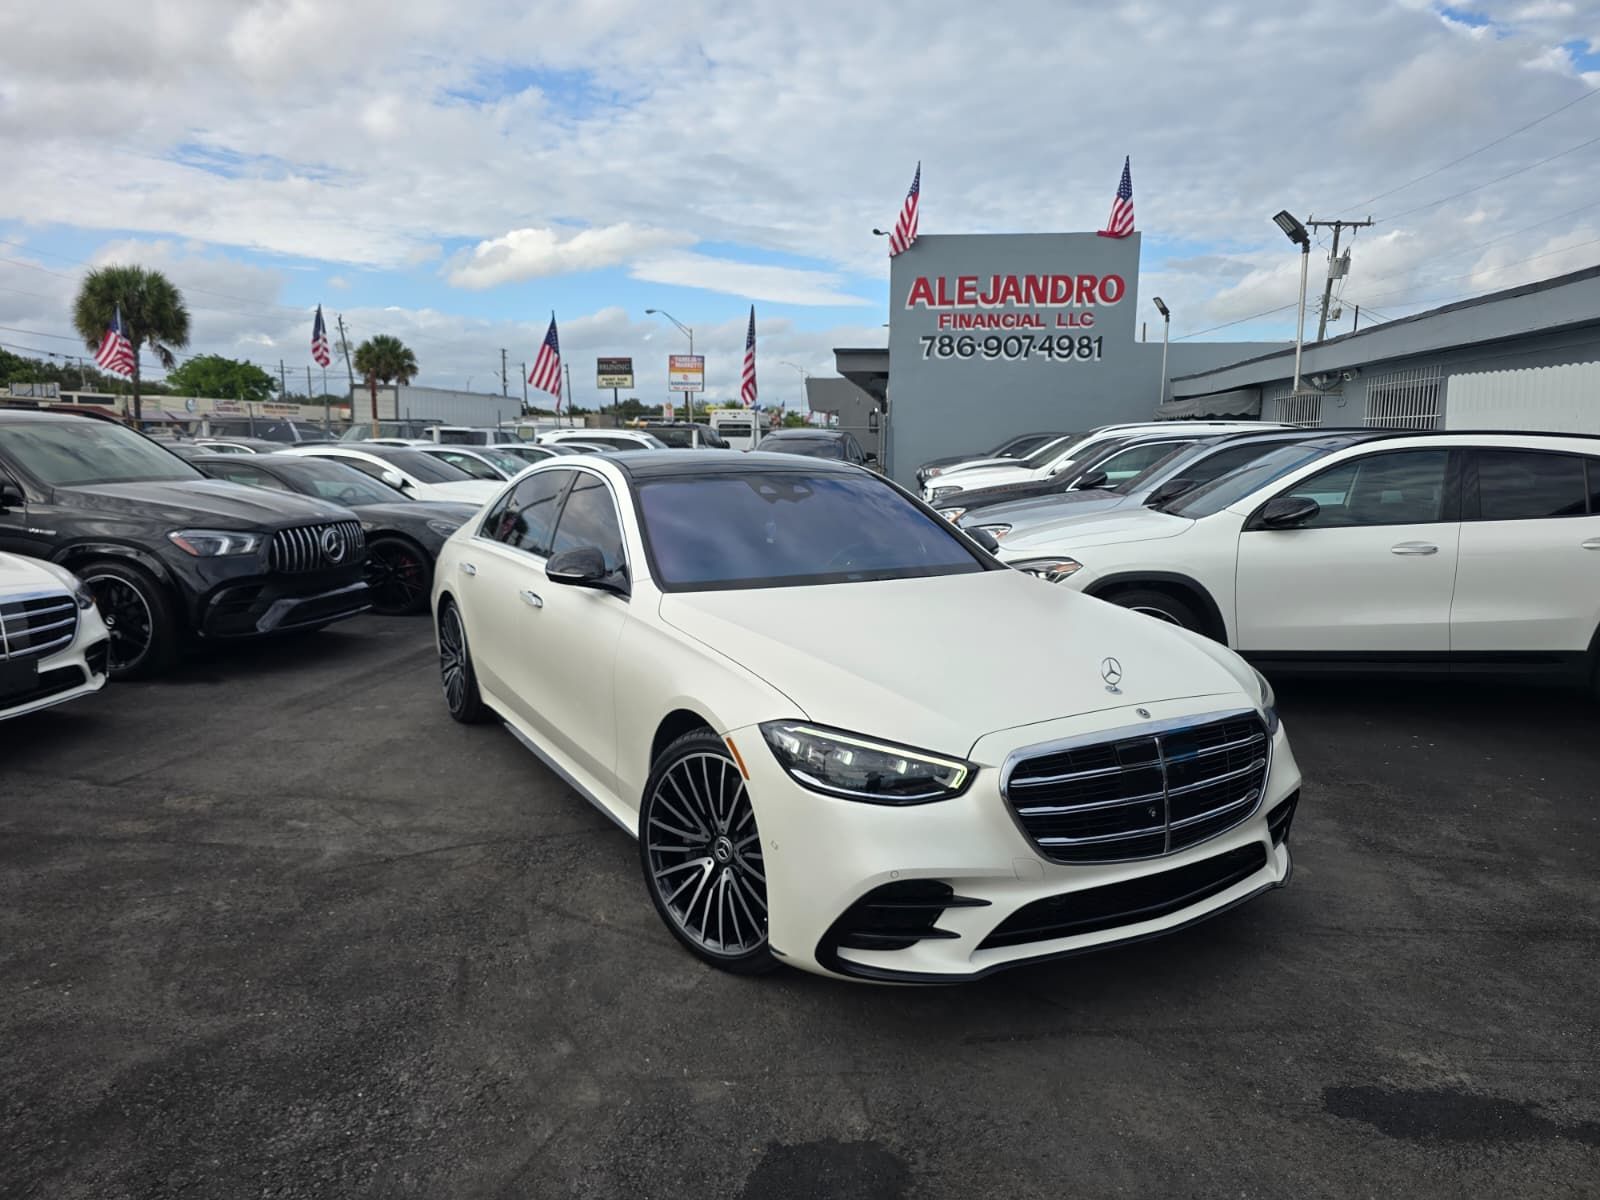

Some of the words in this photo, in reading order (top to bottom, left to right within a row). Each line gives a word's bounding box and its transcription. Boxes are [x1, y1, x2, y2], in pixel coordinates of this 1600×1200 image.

[905, 274, 1125, 309] ALEJANDRO
[938, 312, 1046, 330] FINANCIAL
[1056, 312, 1095, 328] LLC
